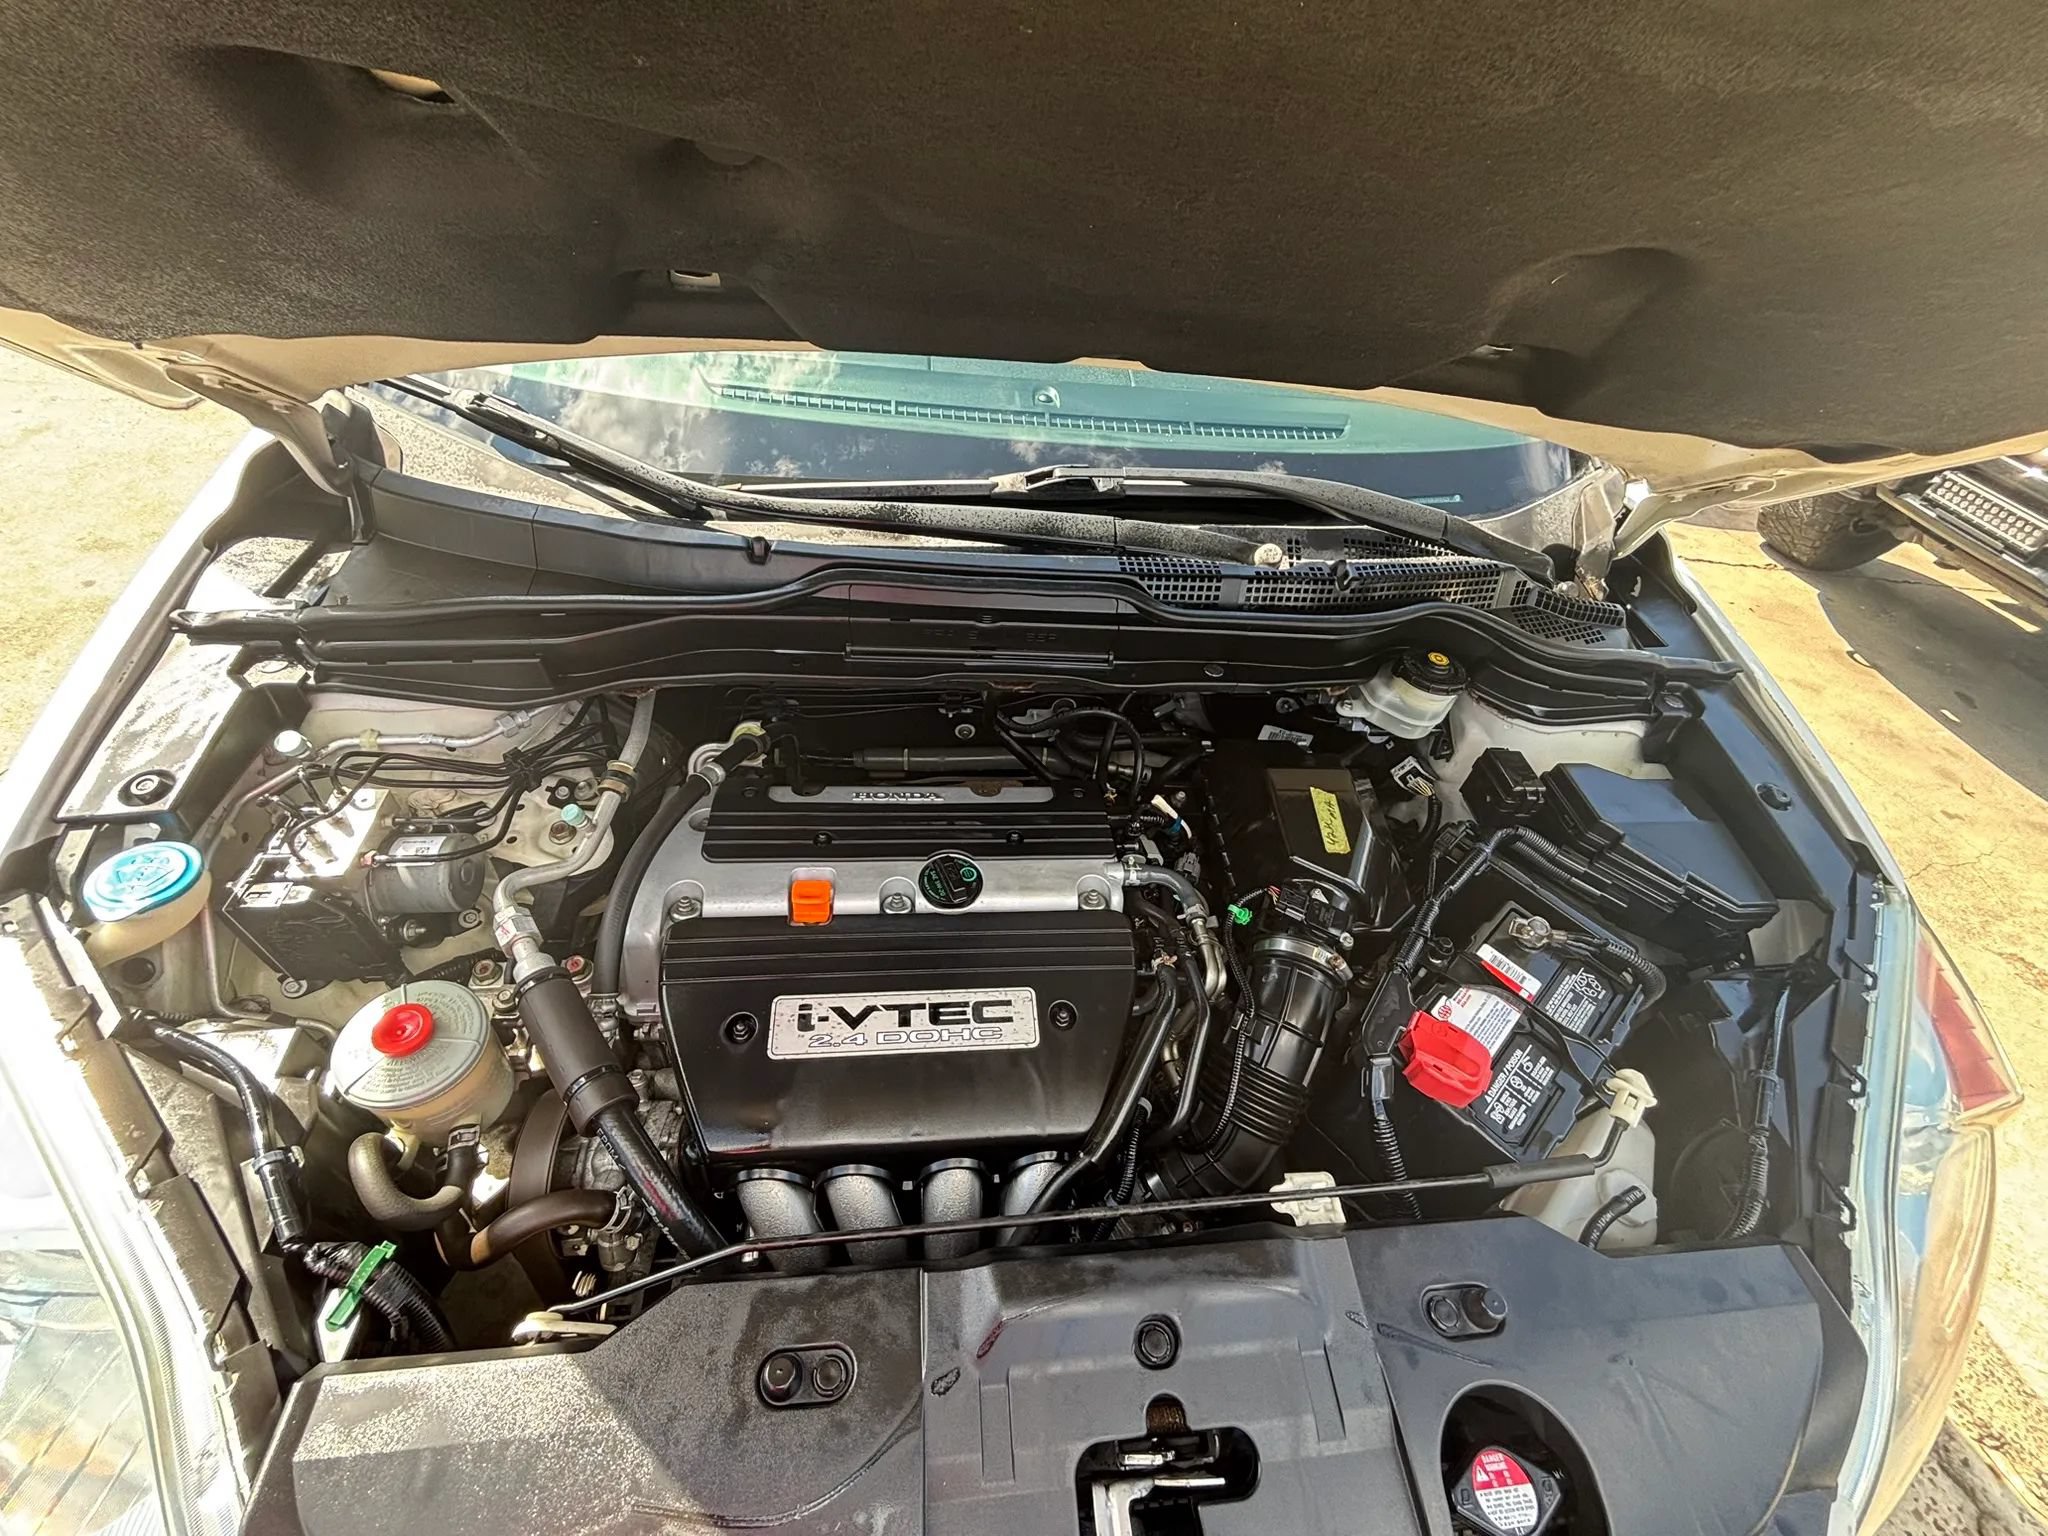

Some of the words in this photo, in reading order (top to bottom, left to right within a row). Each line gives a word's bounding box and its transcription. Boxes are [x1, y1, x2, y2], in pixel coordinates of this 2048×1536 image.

[851, 791, 945, 801] HONDA
[797, 999, 1014, 1032] i-VTEC
[808, 1032, 868, 1048] 2.4
[876, 1026, 1003, 1045] DOHC
[1505, 1048, 1524, 1072] POISON
